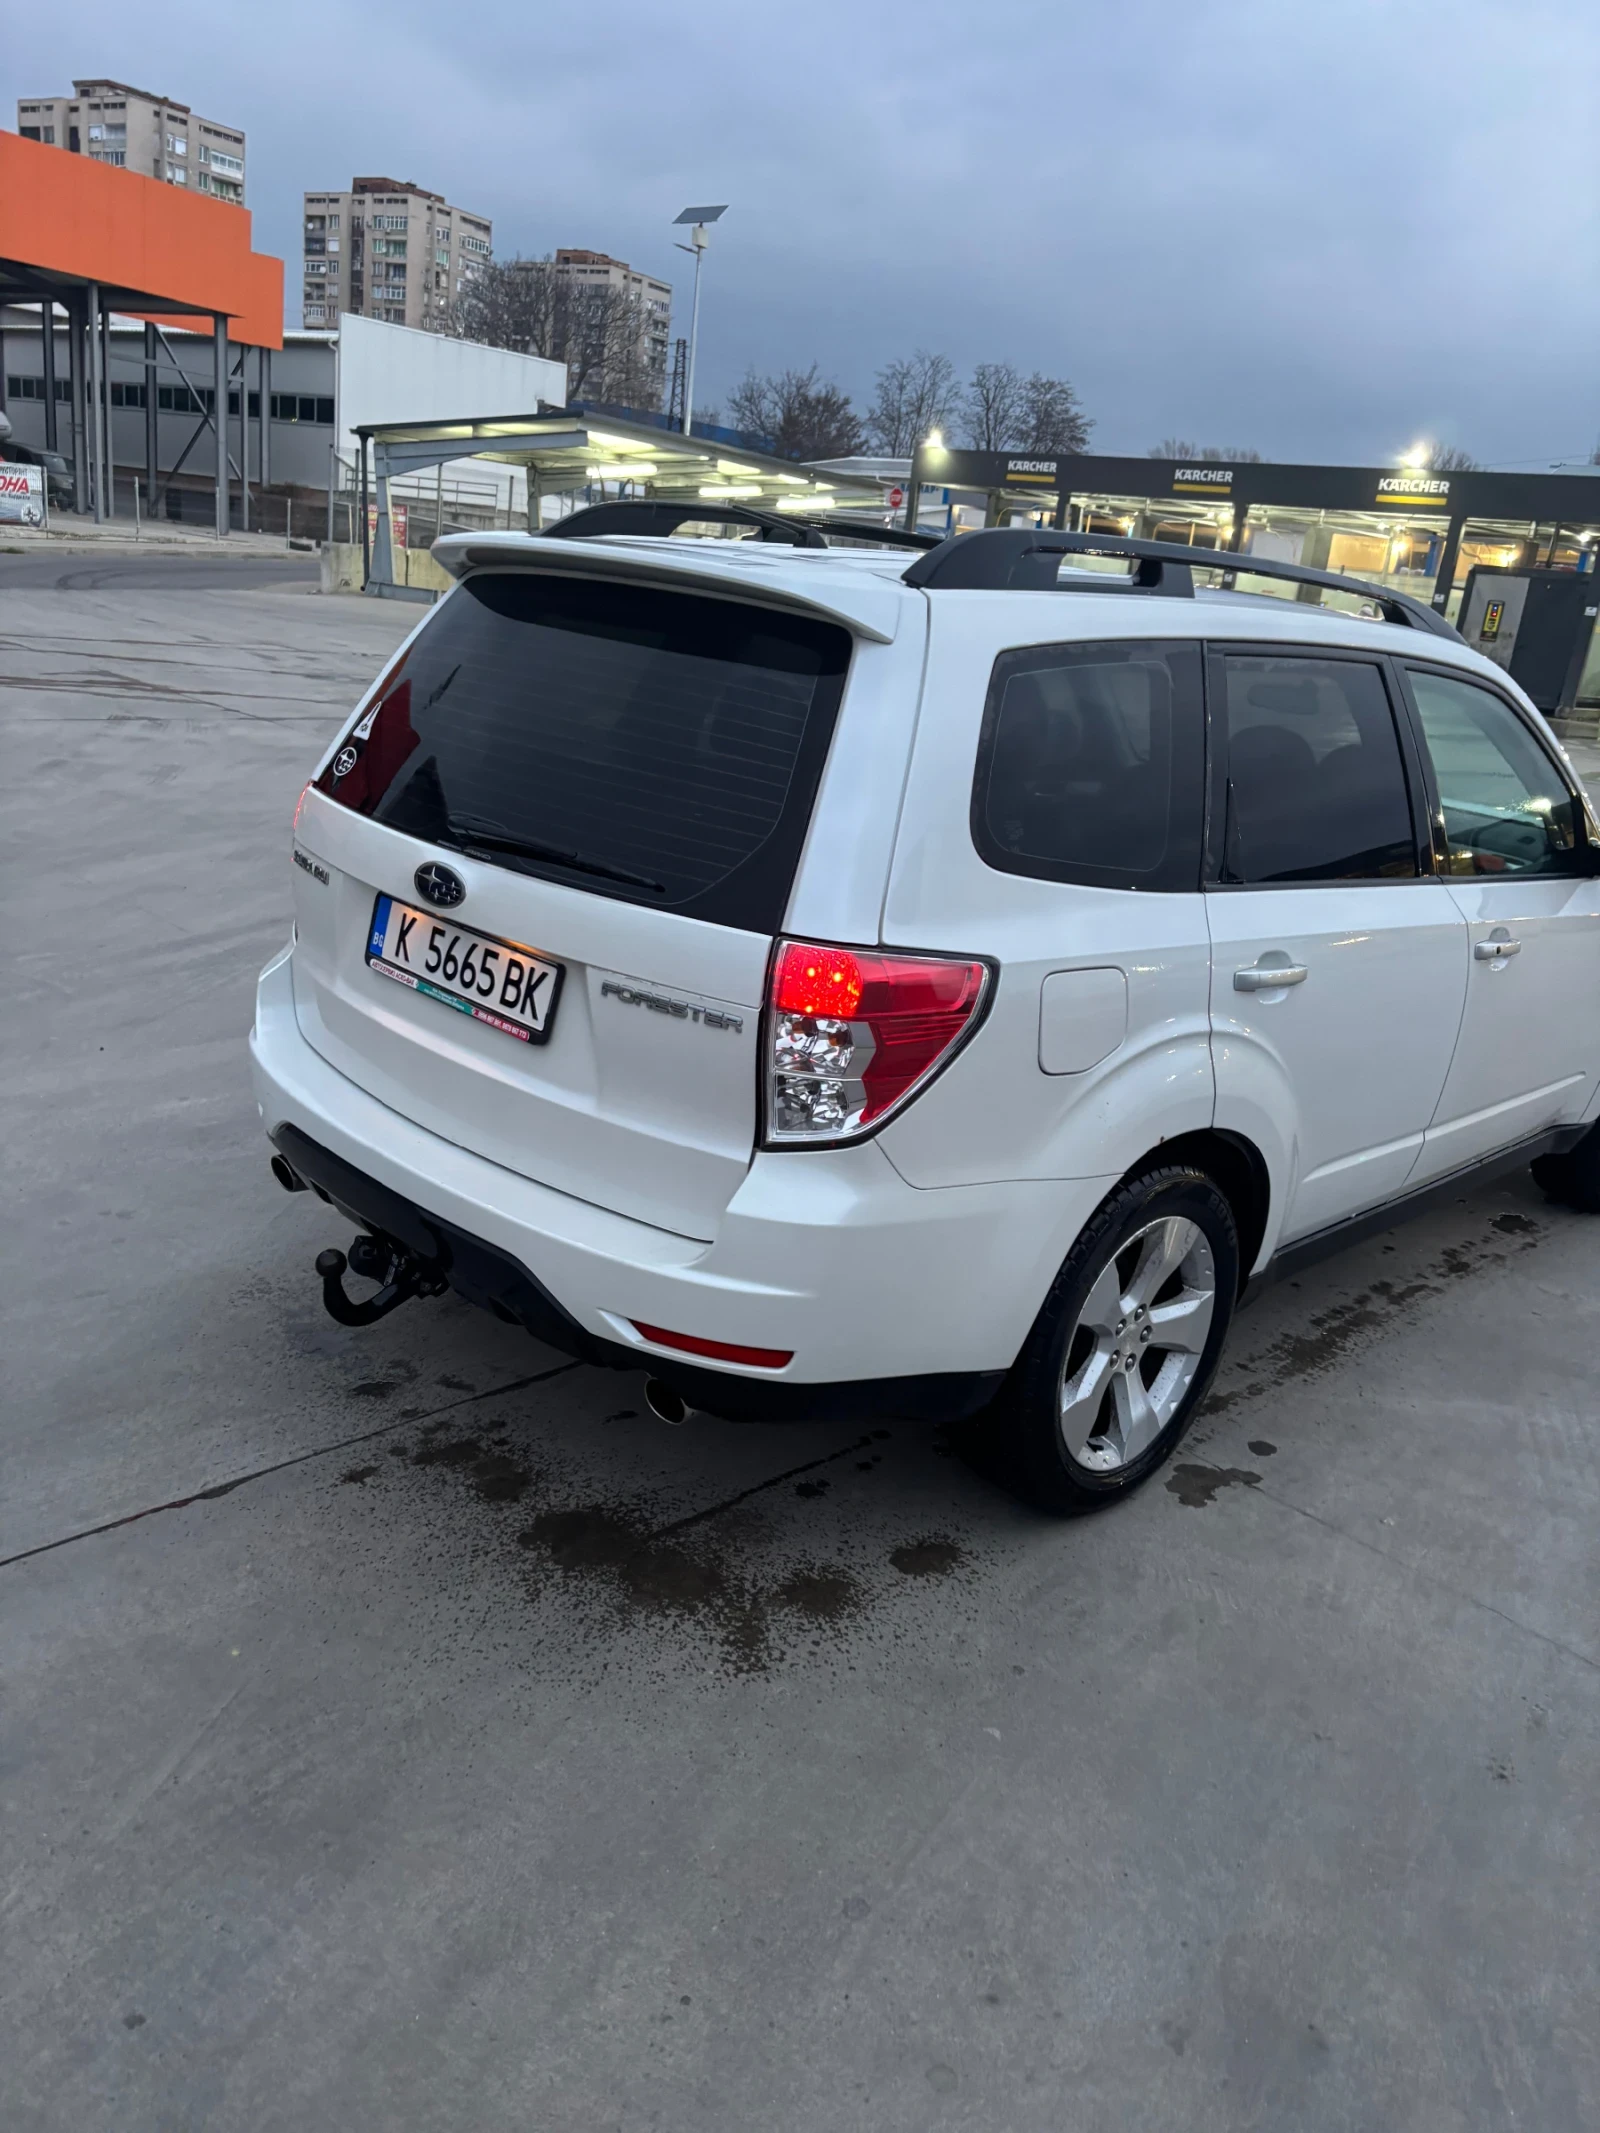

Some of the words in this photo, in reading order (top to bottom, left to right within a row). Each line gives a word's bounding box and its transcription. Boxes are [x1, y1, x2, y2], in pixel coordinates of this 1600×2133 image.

[1007, 459, 1058, 473] KÄRCHER
[1174, 468, 1234, 483] KÄRCHER
[1378, 478, 1451, 494] KÄRCHER
[373, 931, 385, 948] BG
[395, 912, 417, 963] K
[425, 926, 500, 997] 5665
[499, 958, 549, 1021] BK
[601, 979, 744, 1034] FORESTER
